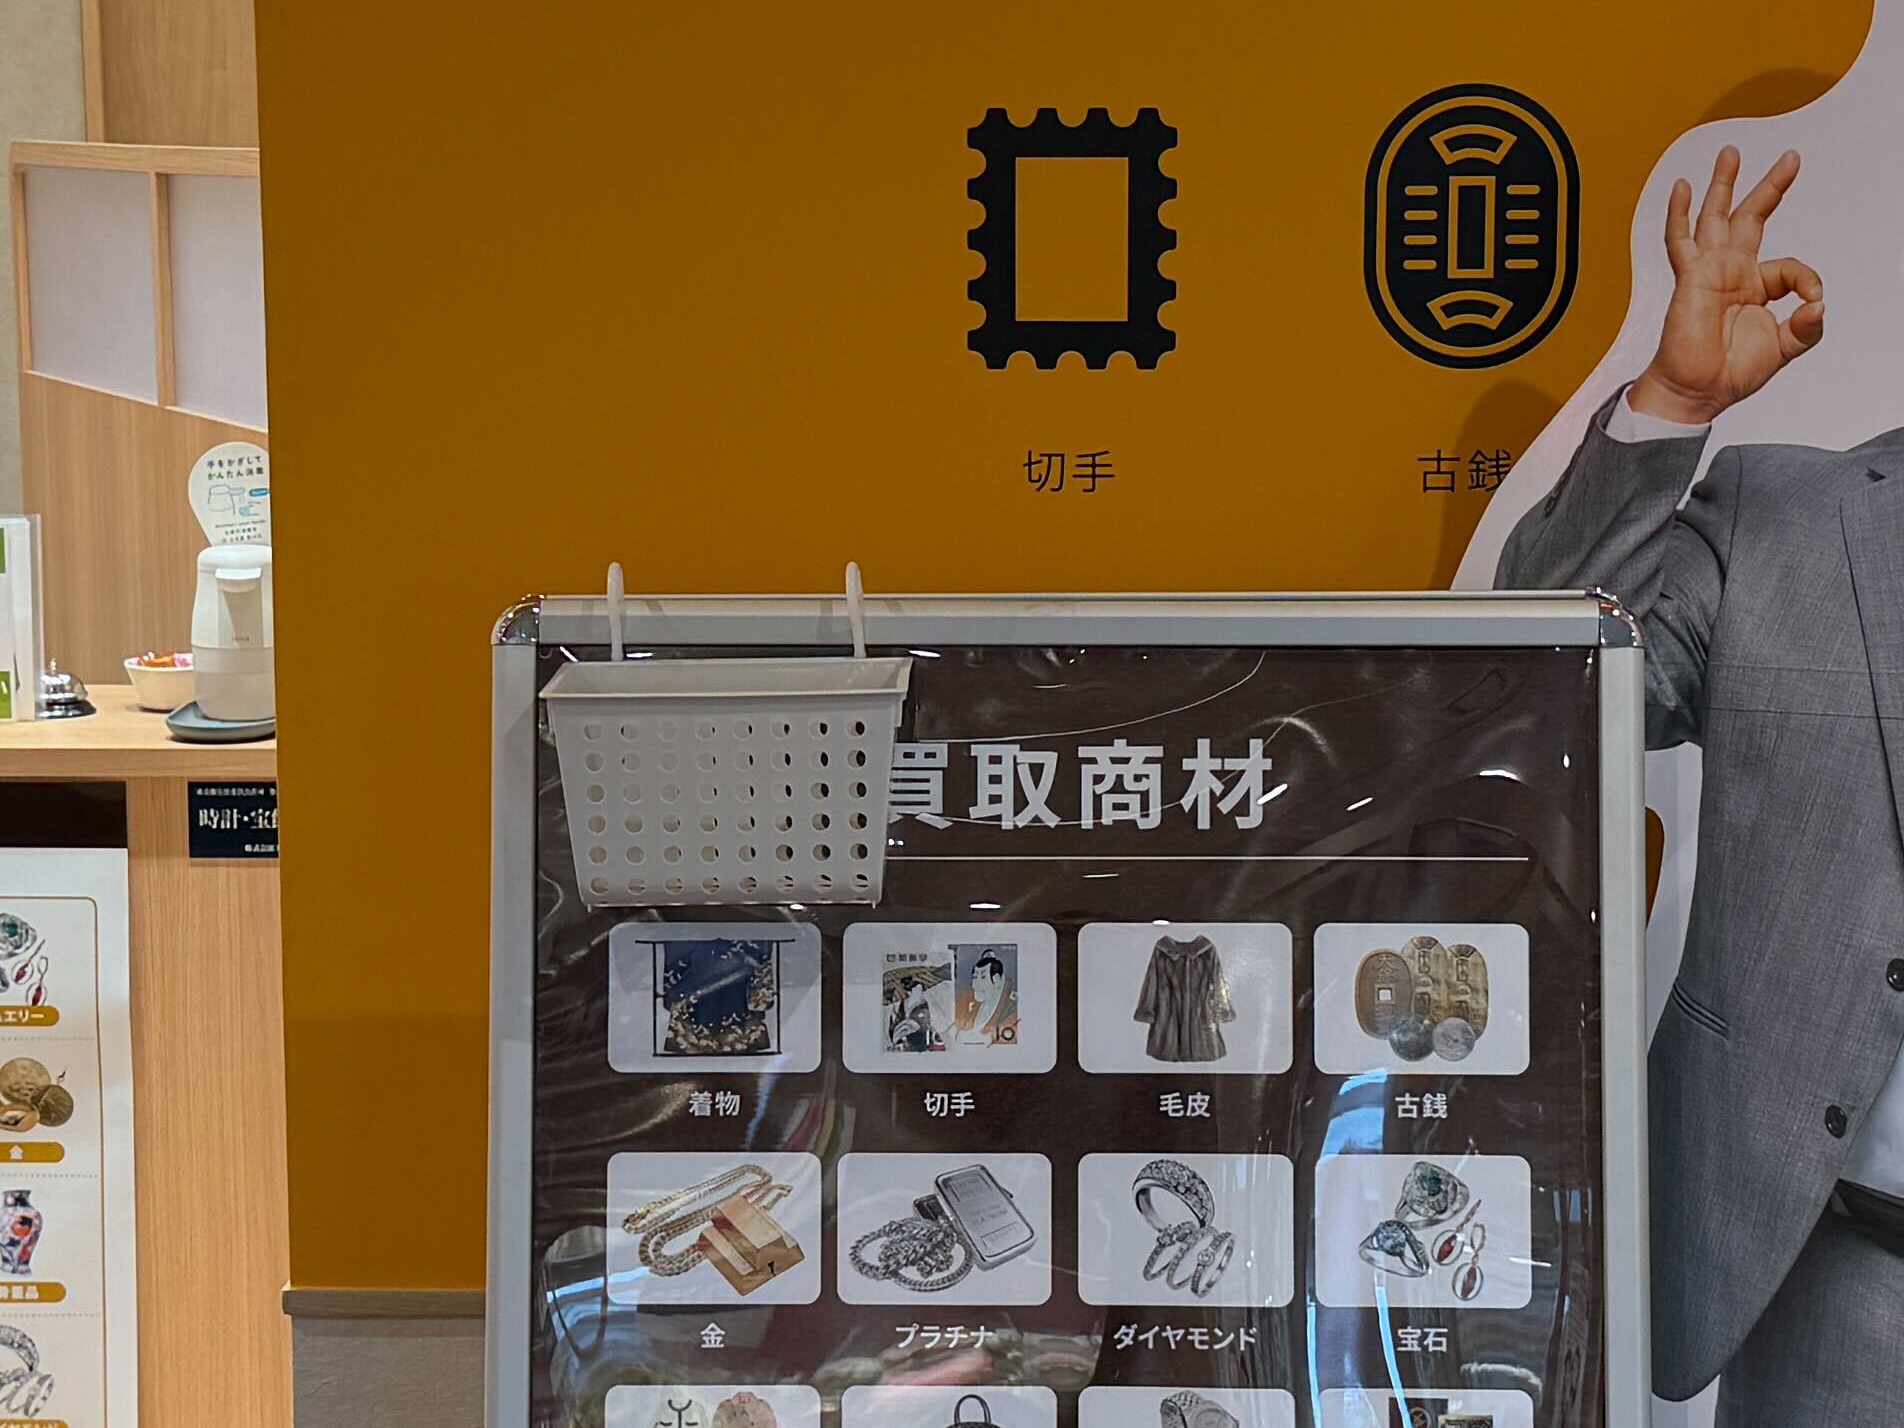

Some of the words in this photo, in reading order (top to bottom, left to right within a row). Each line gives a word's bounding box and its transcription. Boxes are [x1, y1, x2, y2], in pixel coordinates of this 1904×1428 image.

[1022, 449, 1115, 494] 切手
[889, 738, 1274, 834] 買取商材
[687, 1091, 741, 1118] 着物
[923, 1091, 976, 1118] 切手
[1158, 1091, 1211, 1118] 毛皮
[1394, 1091, 1448, 1120] 古銭
[699, 1321, 726, 1350] 金
[895, 1322, 994, 1350] プラチナ
[1112, 1323, 1258, 1352] ダイヤモンド
[1395, 1325, 1449, 1354] 宝石
